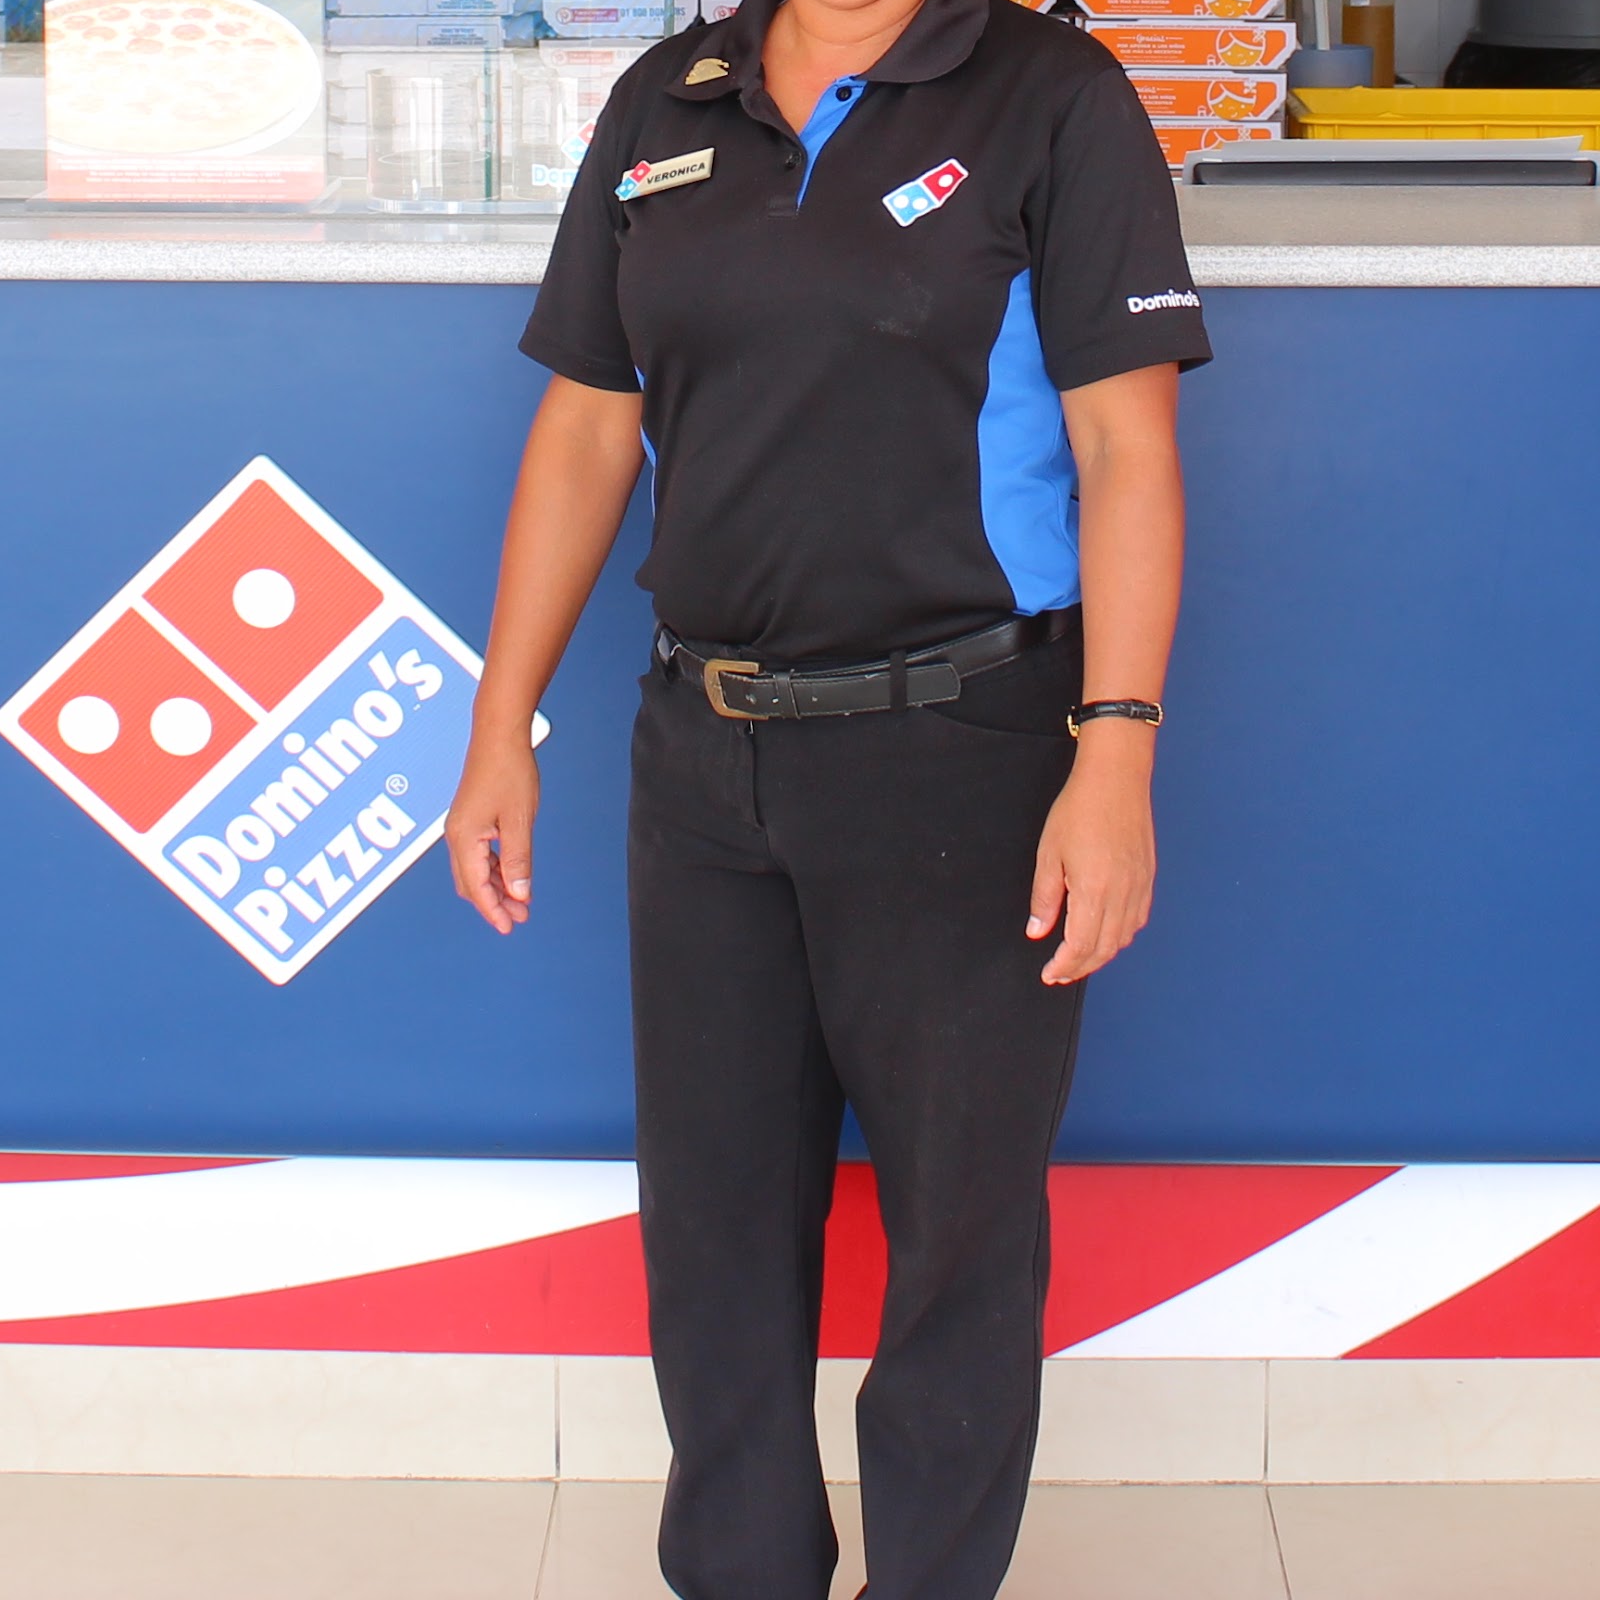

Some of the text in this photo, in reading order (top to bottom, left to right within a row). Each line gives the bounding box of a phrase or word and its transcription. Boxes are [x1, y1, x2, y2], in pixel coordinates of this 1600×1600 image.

[646, 162, 706, 185] VERONICA
[1127, 288, 1200, 314] Domino's
[172, 647, 444, 899] Domino's
[233, 788, 417, 954] Pizza
